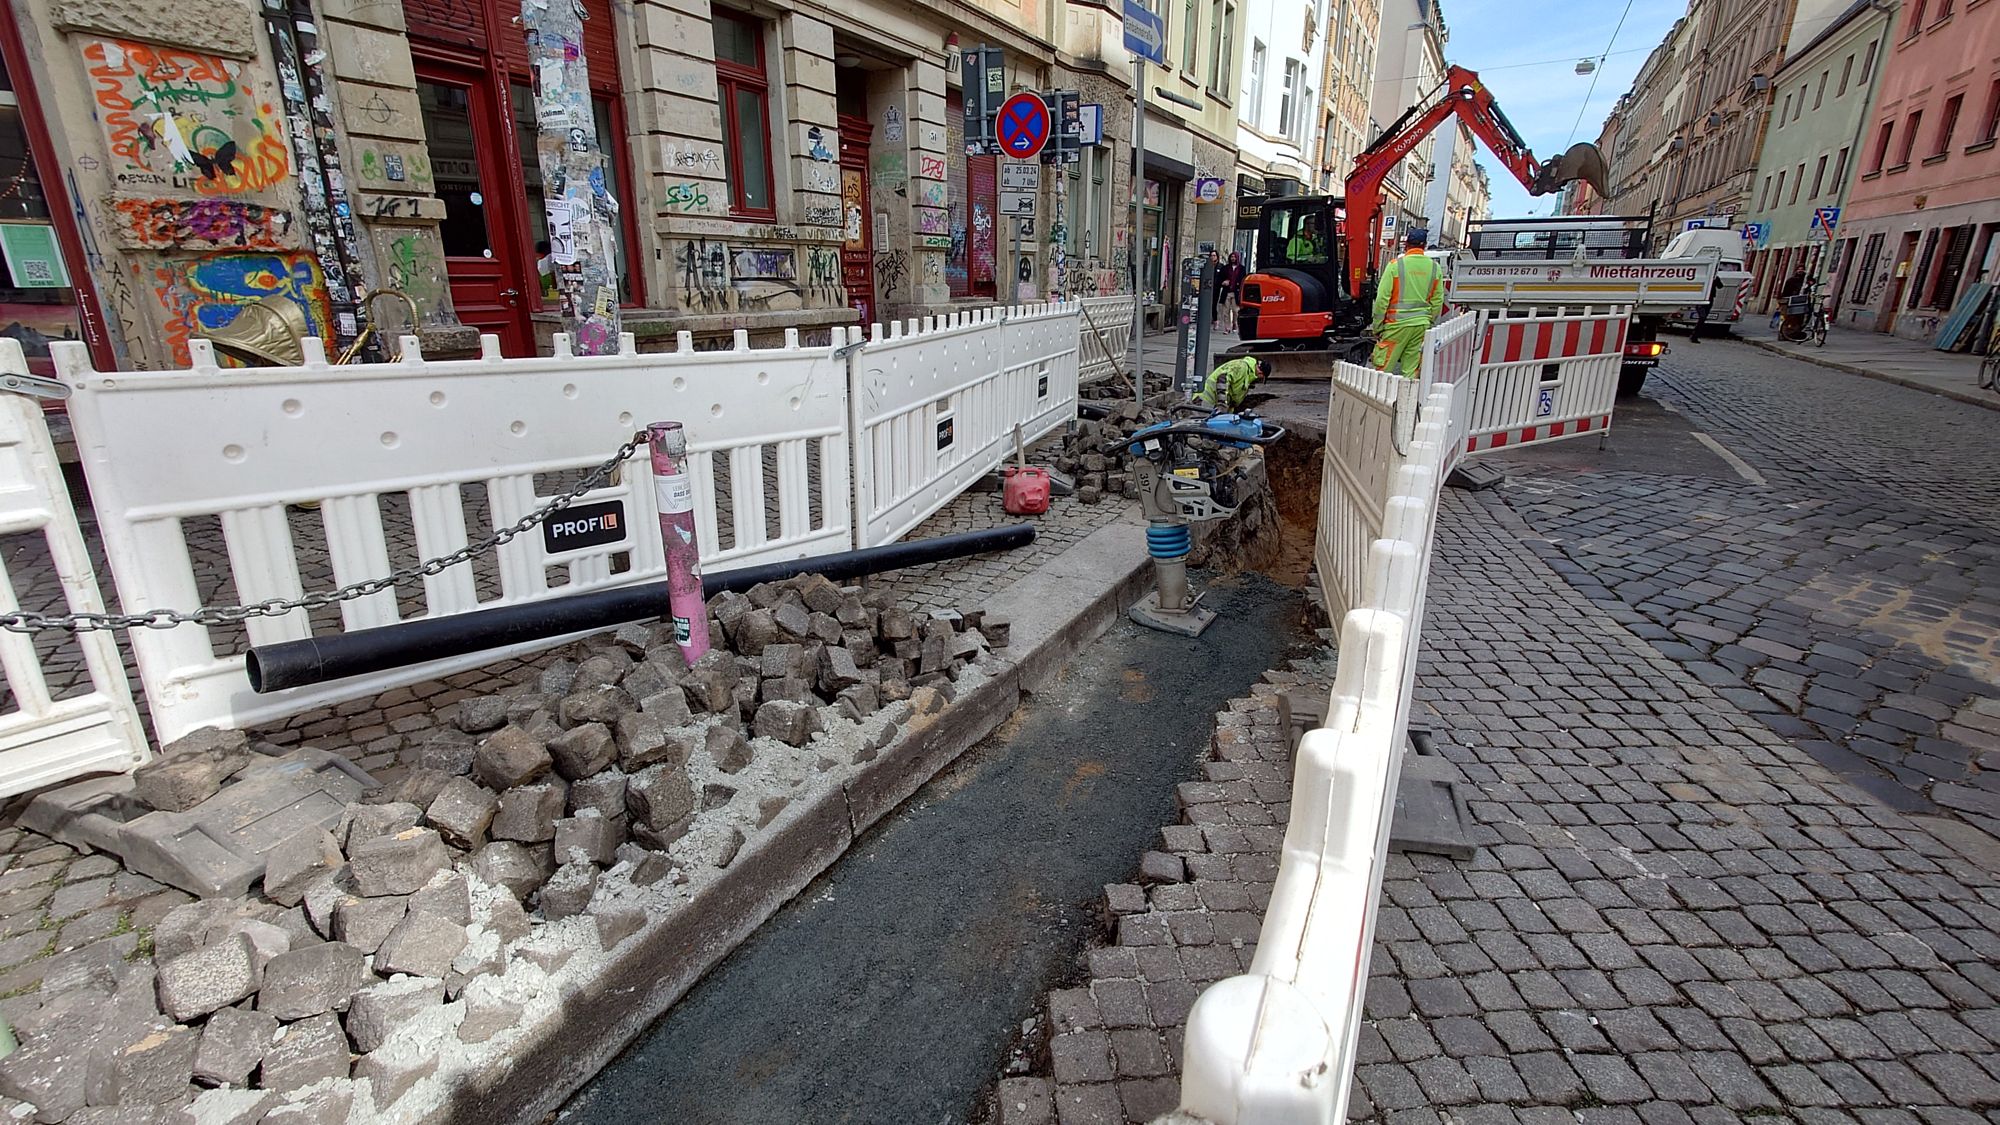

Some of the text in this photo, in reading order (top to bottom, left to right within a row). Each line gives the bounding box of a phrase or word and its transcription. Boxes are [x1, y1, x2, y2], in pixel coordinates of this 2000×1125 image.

[1394, 128, 1423, 153] Kubota
[1004, 166, 1037, 175] ab 25.03.24
[1003, 177, 1010, 185] ab
[1027, 178, 1036, 186] Uhr
[1476, 267, 1495, 275] 0351
[1497, 267, 1507, 275] 81
[1590, 265, 1697, 280] Mietfahrzeug
[1139, 473, 1152, 494] 397
[552, 513, 617, 538] PROFIL
